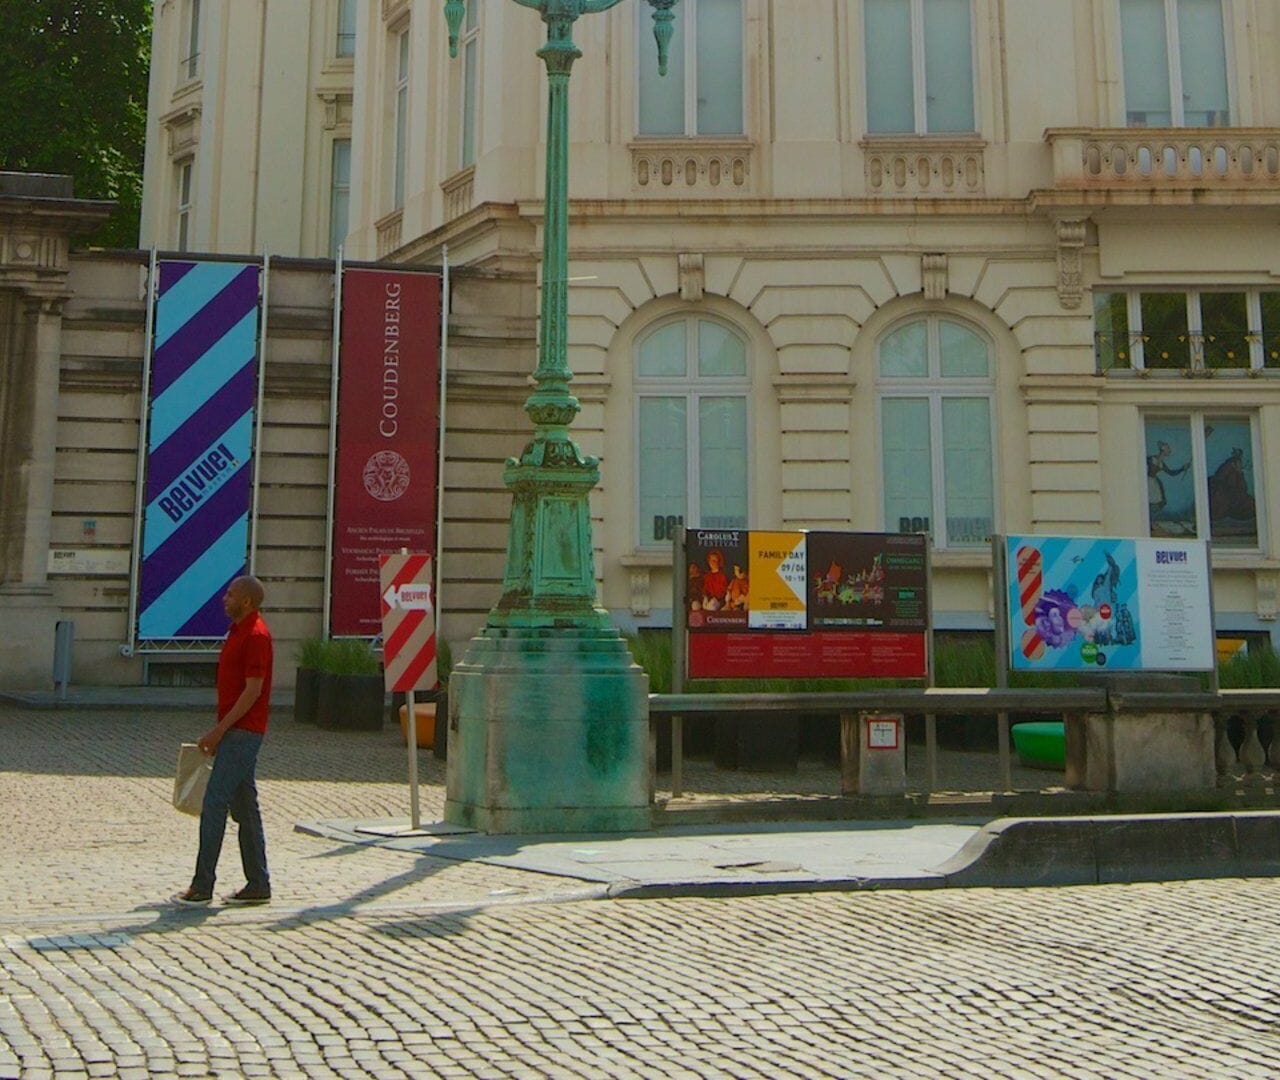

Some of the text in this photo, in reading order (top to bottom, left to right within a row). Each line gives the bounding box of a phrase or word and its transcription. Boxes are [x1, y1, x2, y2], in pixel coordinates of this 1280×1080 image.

[379, 282, 402, 439] COUDENBERG
[758, 550, 805, 560] FAMILY DAY
